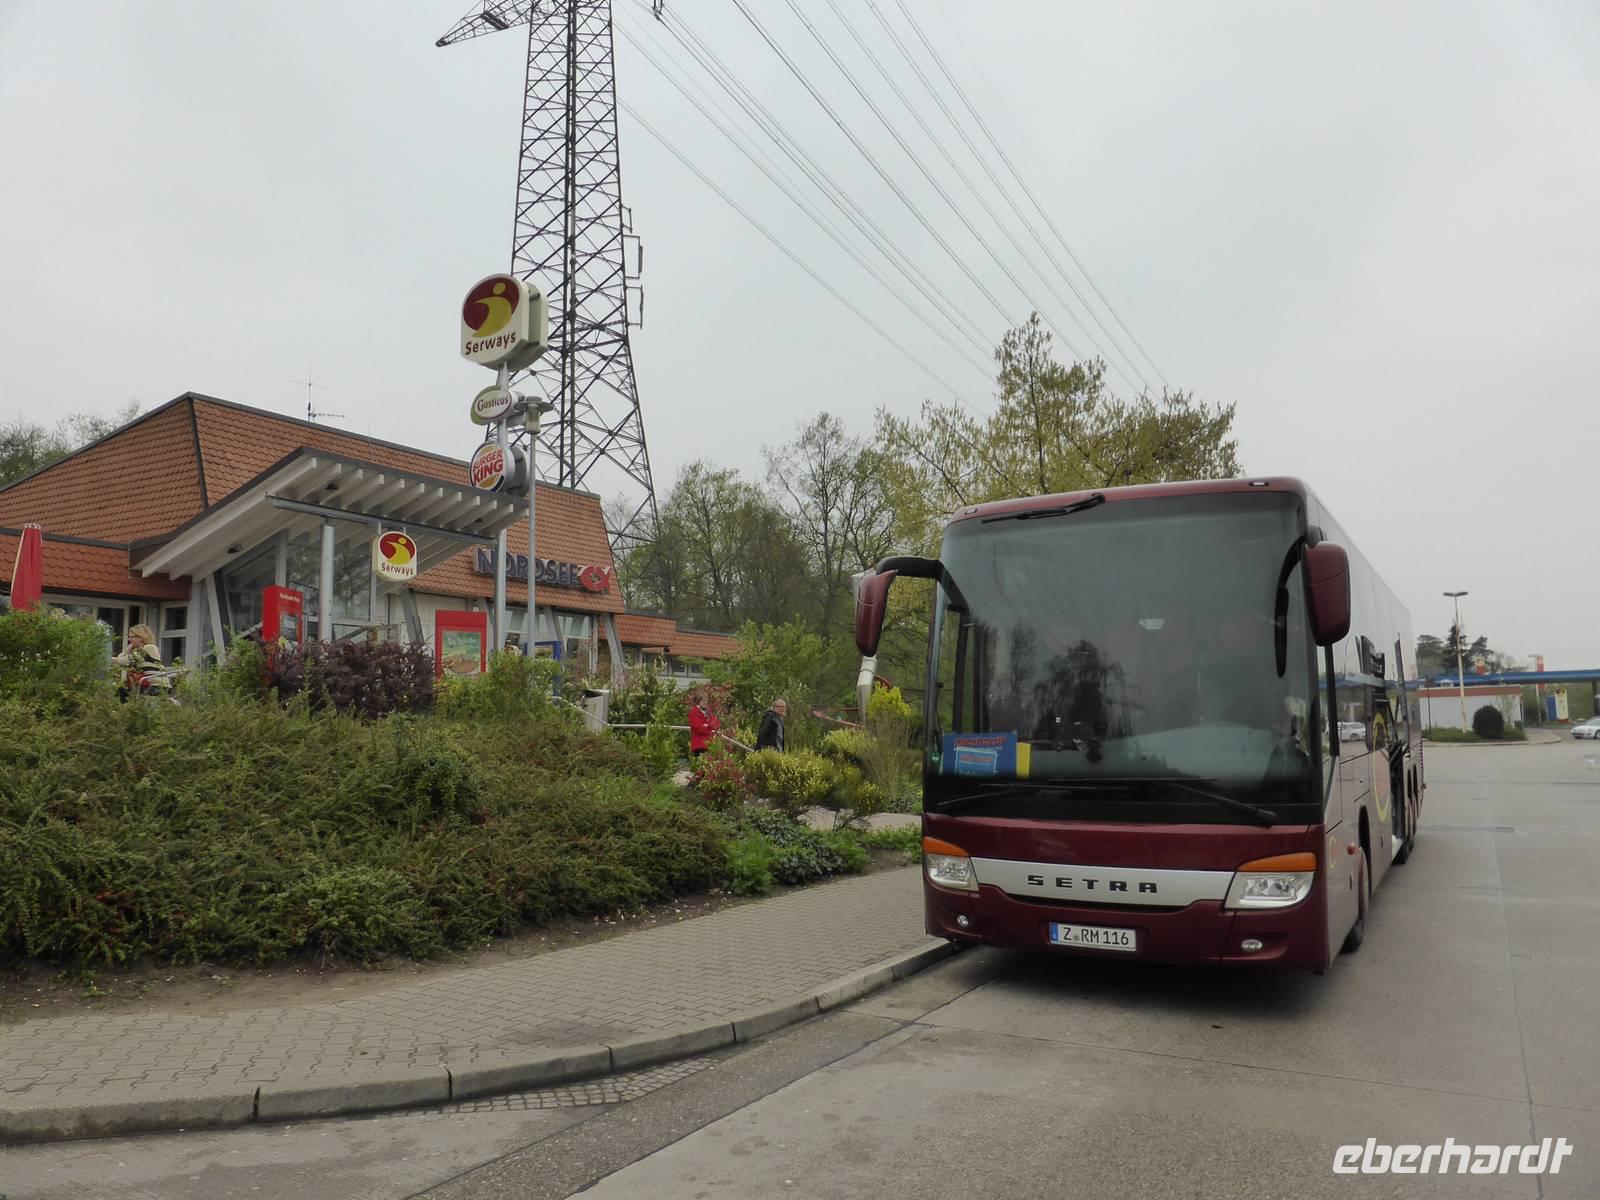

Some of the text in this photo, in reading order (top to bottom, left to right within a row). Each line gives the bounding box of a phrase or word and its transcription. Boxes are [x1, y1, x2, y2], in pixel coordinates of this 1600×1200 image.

[465, 332, 516, 356] Serways
[477, 396, 509, 412] Gusticus
[473, 449, 503, 472] BURGER
[473, 458, 504, 485] KING
[381, 562, 414, 576] Serways
[1027, 875, 1158, 894] SETRA
[1063, 926, 1073, 941] Z
